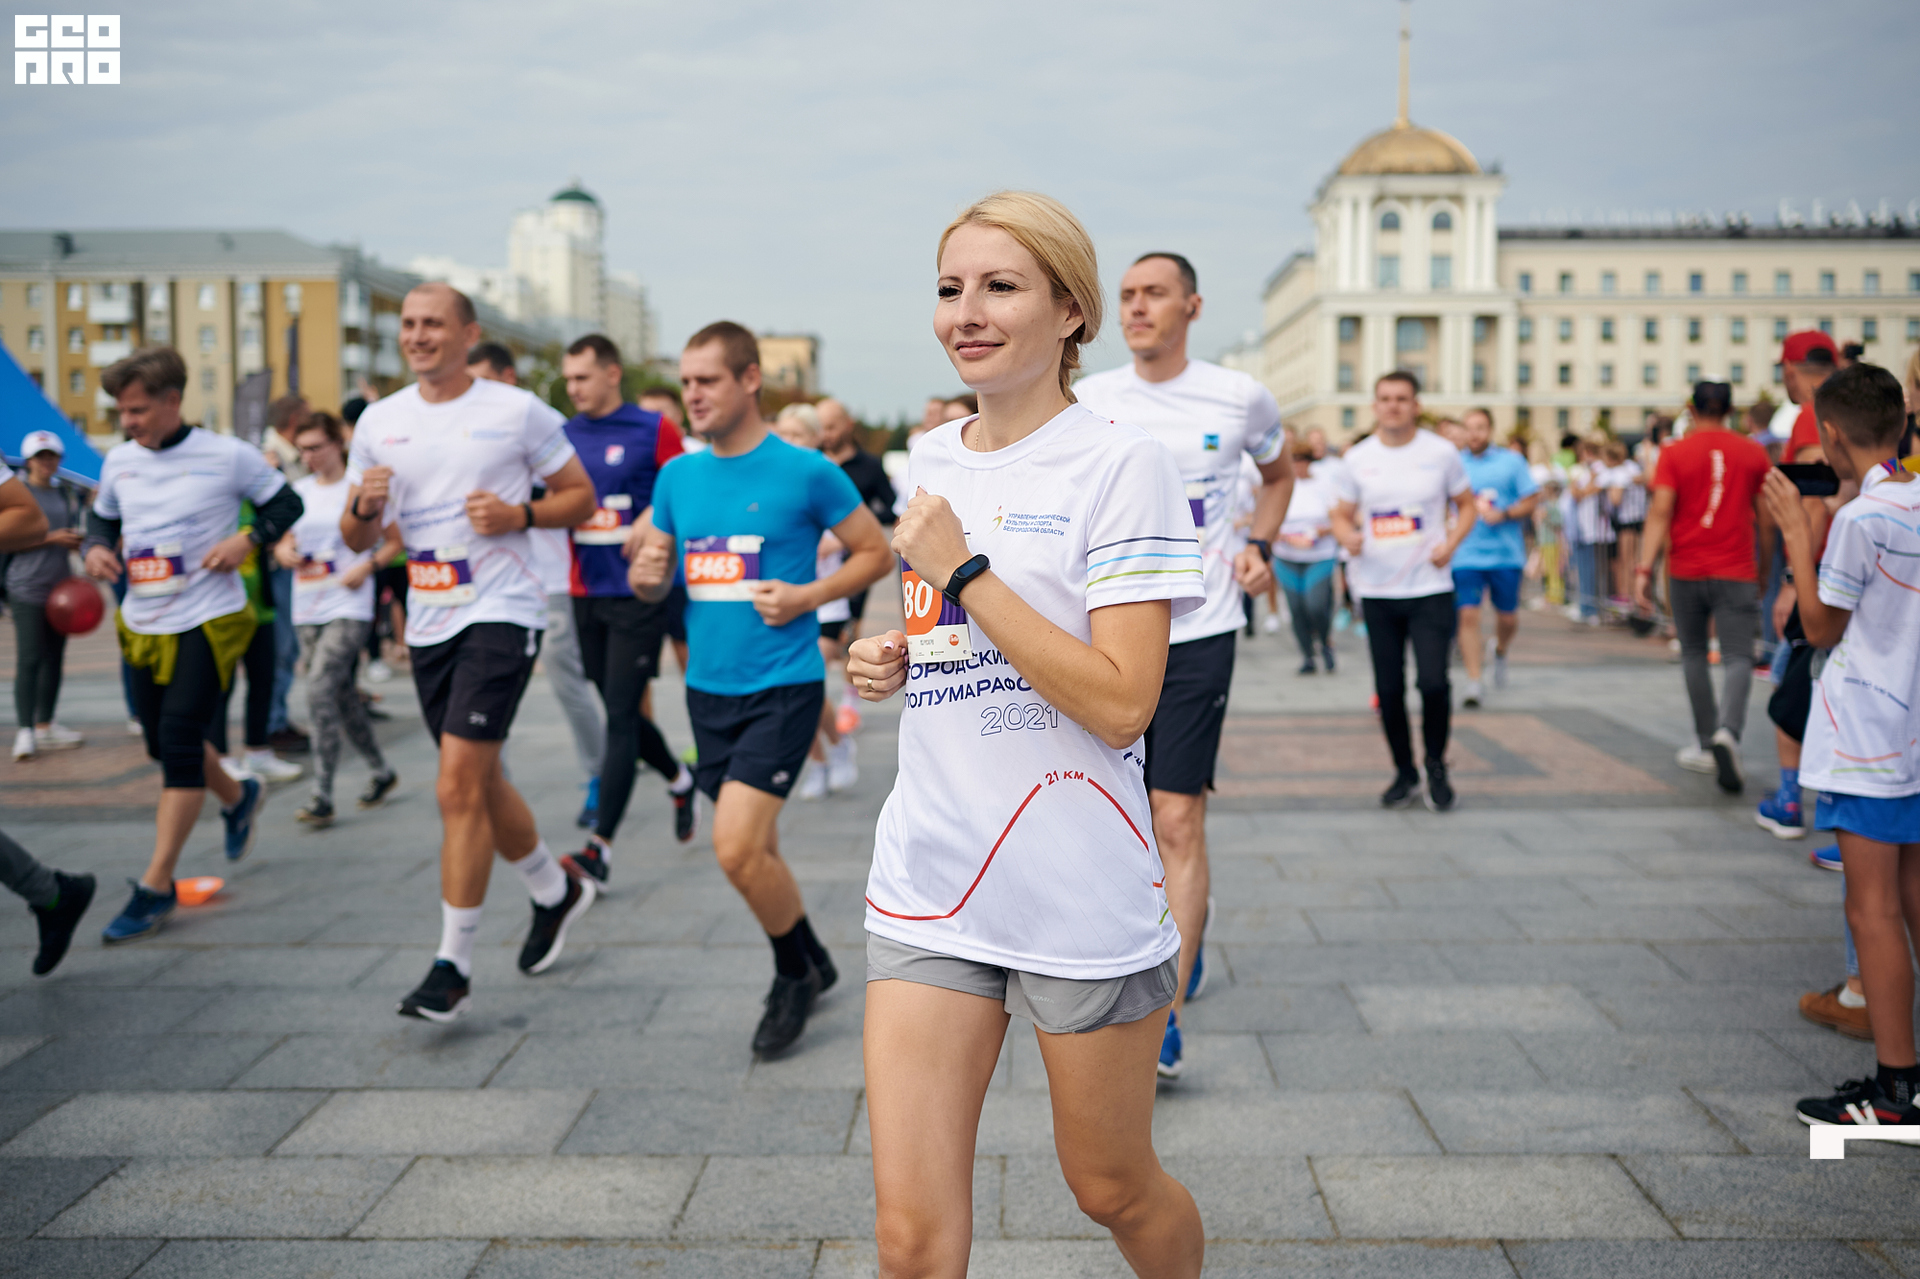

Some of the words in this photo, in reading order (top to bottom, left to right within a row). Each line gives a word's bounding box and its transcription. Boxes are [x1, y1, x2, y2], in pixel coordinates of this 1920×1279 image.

[1008, 512, 1038, 520] УПРАВЛЕНИЕ
[1038, 513, 1071, 523] ФИЗИЧЕСКОЙ
[1003, 525, 1039, 533] БЕЛГОРОДСКОЙ
[1040, 527, 1065, 537] ОБЛАСТИ
[980, 702, 1059, 737] 2021
[1045, 770, 1060, 786] 21
